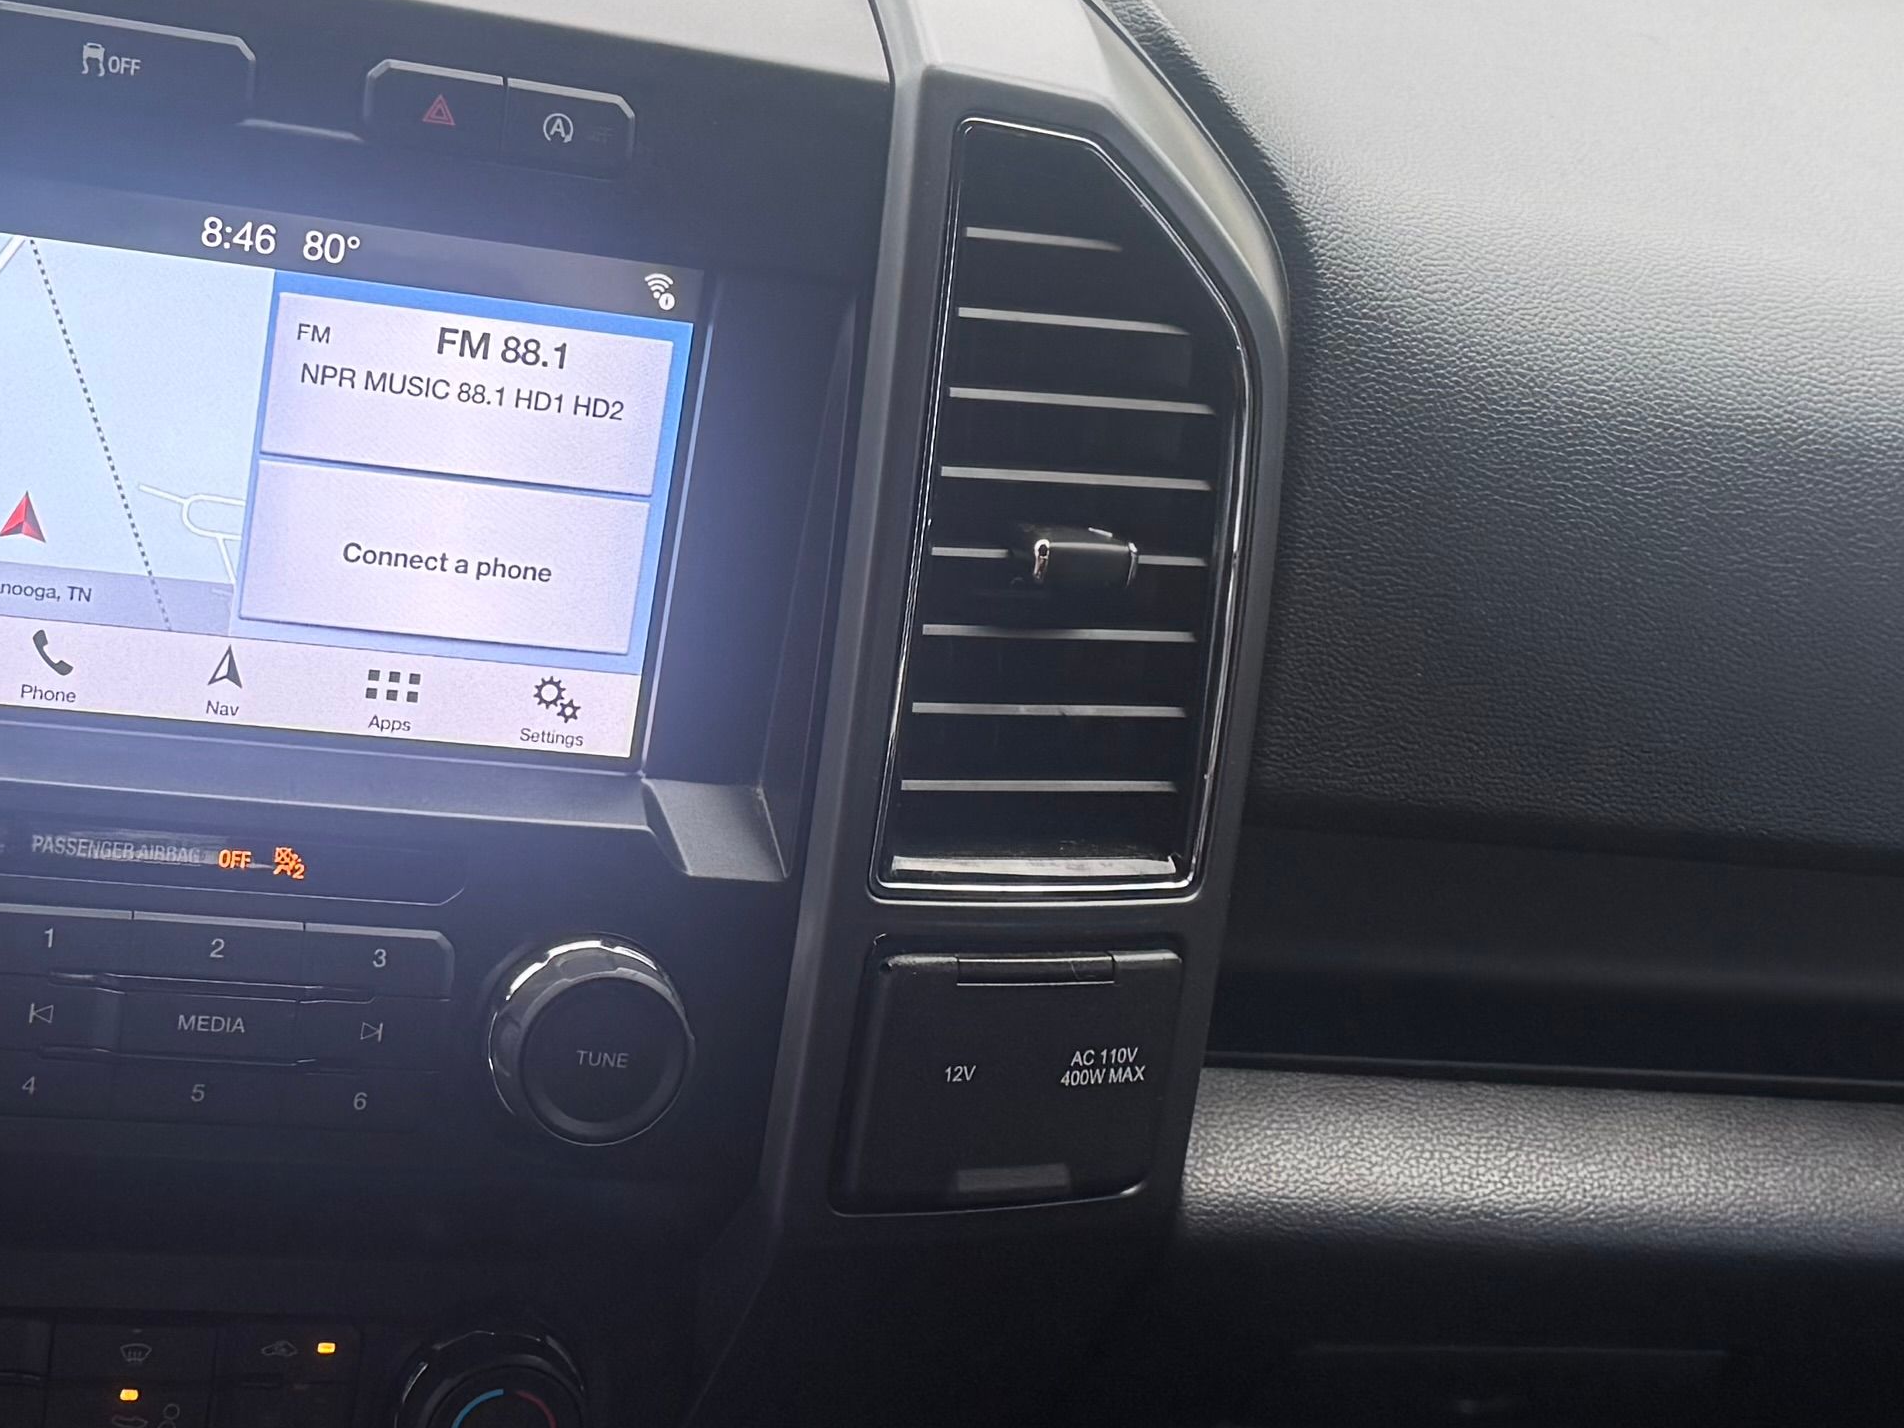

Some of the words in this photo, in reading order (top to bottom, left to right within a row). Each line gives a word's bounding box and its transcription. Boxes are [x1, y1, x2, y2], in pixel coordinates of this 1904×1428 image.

[108, 55, 142, 76] OFF
[201, 216, 277, 254] 8:46
[302, 230, 361, 264] 80°
[297, 323, 331, 344] FM
[436, 327, 491, 360] FM
[501, 336, 568, 370] 88.1
[300, 363, 357, 389] NPR
[364, 370, 450, 400] MUSIC
[457, 382, 505, 407] 88.1
[514, 388, 565, 414] HD1
[573, 395, 624, 421] HD2
[342, 541, 448, 572] Connect
[454, 558, 469, 574] a
[475, 557, 553, 583] phone
[67, 586, 92, 603] TN
[20, 684, 77, 703] Phone
[206, 700, 240, 717] Nav
[367, 715, 412, 732] Apps
[519, 727, 584, 747] Settings
[31, 834, 134, 861] PASSENGER
[139, 845, 201, 864] AIRBAG
[218, 849, 252, 869] OFF
[44, 928, 55, 948] 1
[209, 938, 225, 958] 2
[372, 948, 387, 968] 3
[177, 1014, 245, 1034] MEDIA
[576, 1050, 629, 1068] TUNE
[1070, 1049, 1096, 1067] AC
[1100, 1047, 1139, 1065] 110V
[944, 1065, 976, 1083] 12V
[1060, 1068, 1107, 1087] 400W
[1108, 1065, 1146, 1084] MAX
[21, 1076, 36, 1095] 4
[191, 1084, 206, 1102] 5
[353, 1091, 368, 1110] 6
